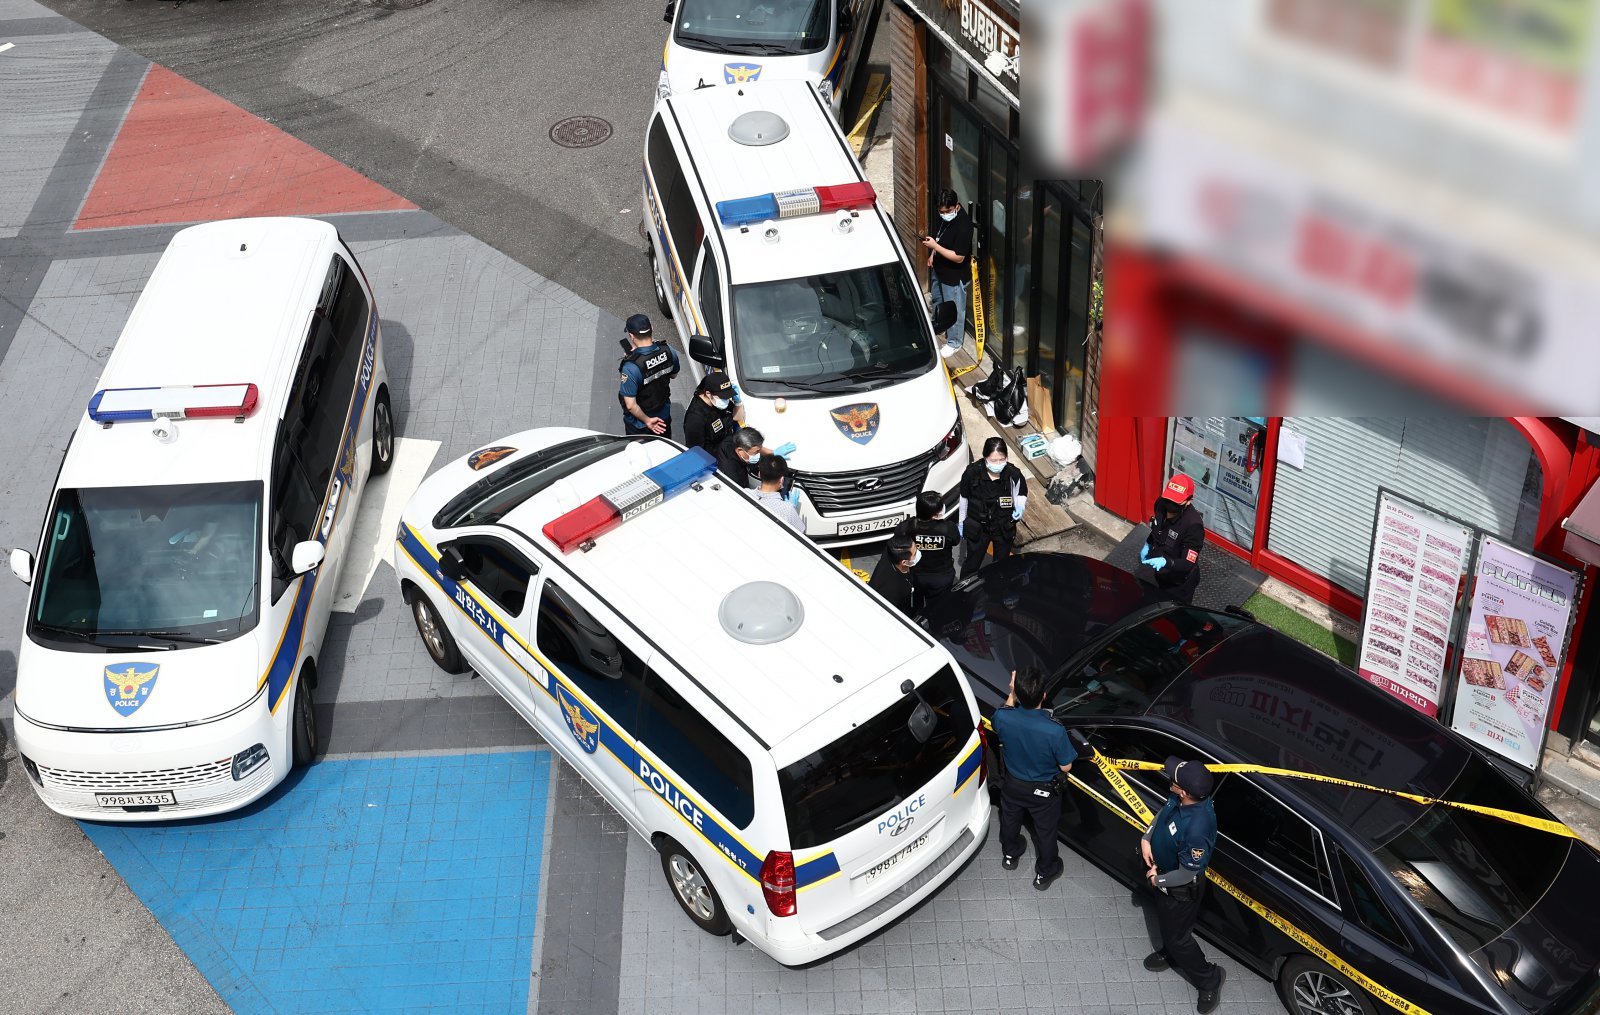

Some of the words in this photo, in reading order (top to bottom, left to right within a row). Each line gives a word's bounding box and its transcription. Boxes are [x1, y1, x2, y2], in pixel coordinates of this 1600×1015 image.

[360, 337, 375, 391] POLICE
[645, 352, 668, 369] POLICE
[851, 430, 873, 438] POLICE
[625, 496, 661, 519] POLICE
[915, 535, 943, 544] 학수사
[1482, 560, 1567, 607] PLATTER
[455, 584, 498, 639] 과학수사
[1389, 682, 1428, 708] 피자먹다
[1487, 729, 1521, 751] 피자먹다
[639, 759, 704, 832] POLICE
[877, 793, 926, 834] POLICE
